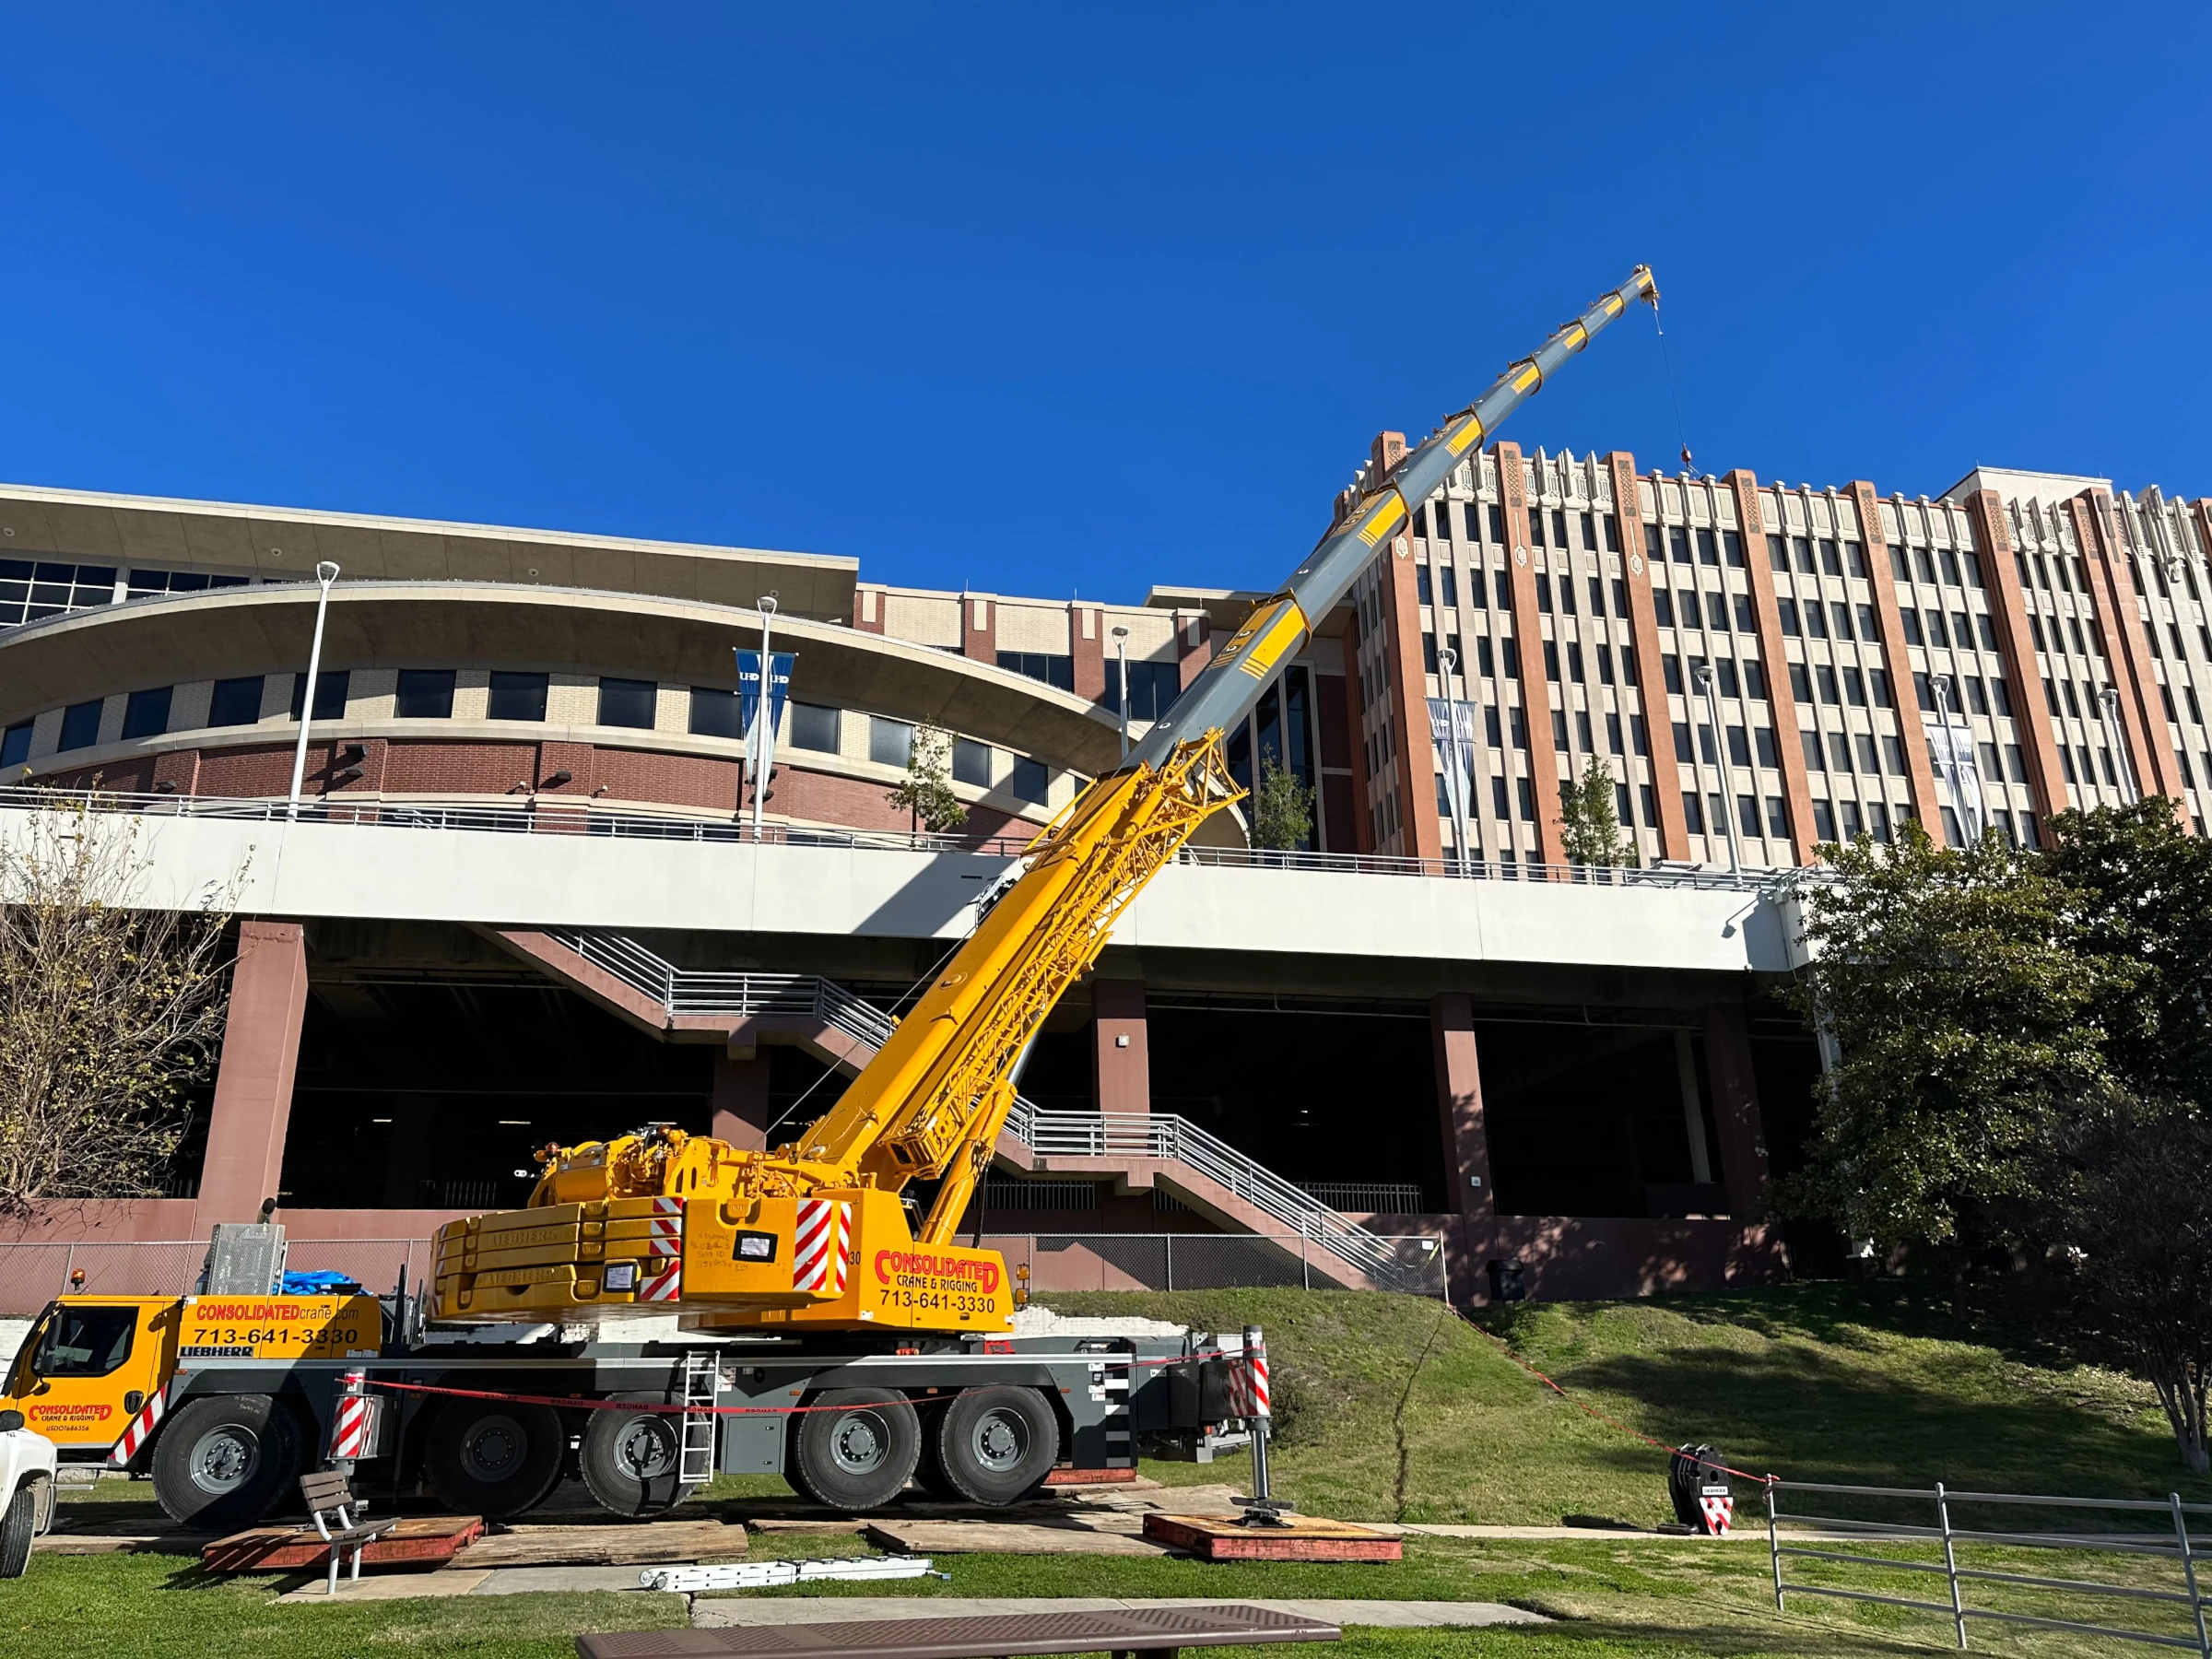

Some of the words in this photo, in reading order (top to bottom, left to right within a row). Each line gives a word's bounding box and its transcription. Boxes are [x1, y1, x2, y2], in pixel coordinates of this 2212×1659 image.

[739, 672, 759, 681] UHD
[492, 1229, 559, 1247] LIEBHERR
[846, 1251, 861, 1265] 30
[489, 1268, 556, 1286] LIEBHERR
[875, 1250, 999, 1294] CONSOLIDATED
[897, 1275, 927, 1289] CRANE
[930, 1279, 937, 1289] &
[940, 1279, 977, 1293] RIGGING
[879, 1289, 995, 1313] 713-641-3330
[196, 1304, 359, 1320] CONSOLIDATEDcranecom
[194, 1328, 359, 1344] 713-641-3330
[180, 1347, 253, 1357] LIEBHERR
[29, 1404, 112, 1421] CONSOLIDATED
